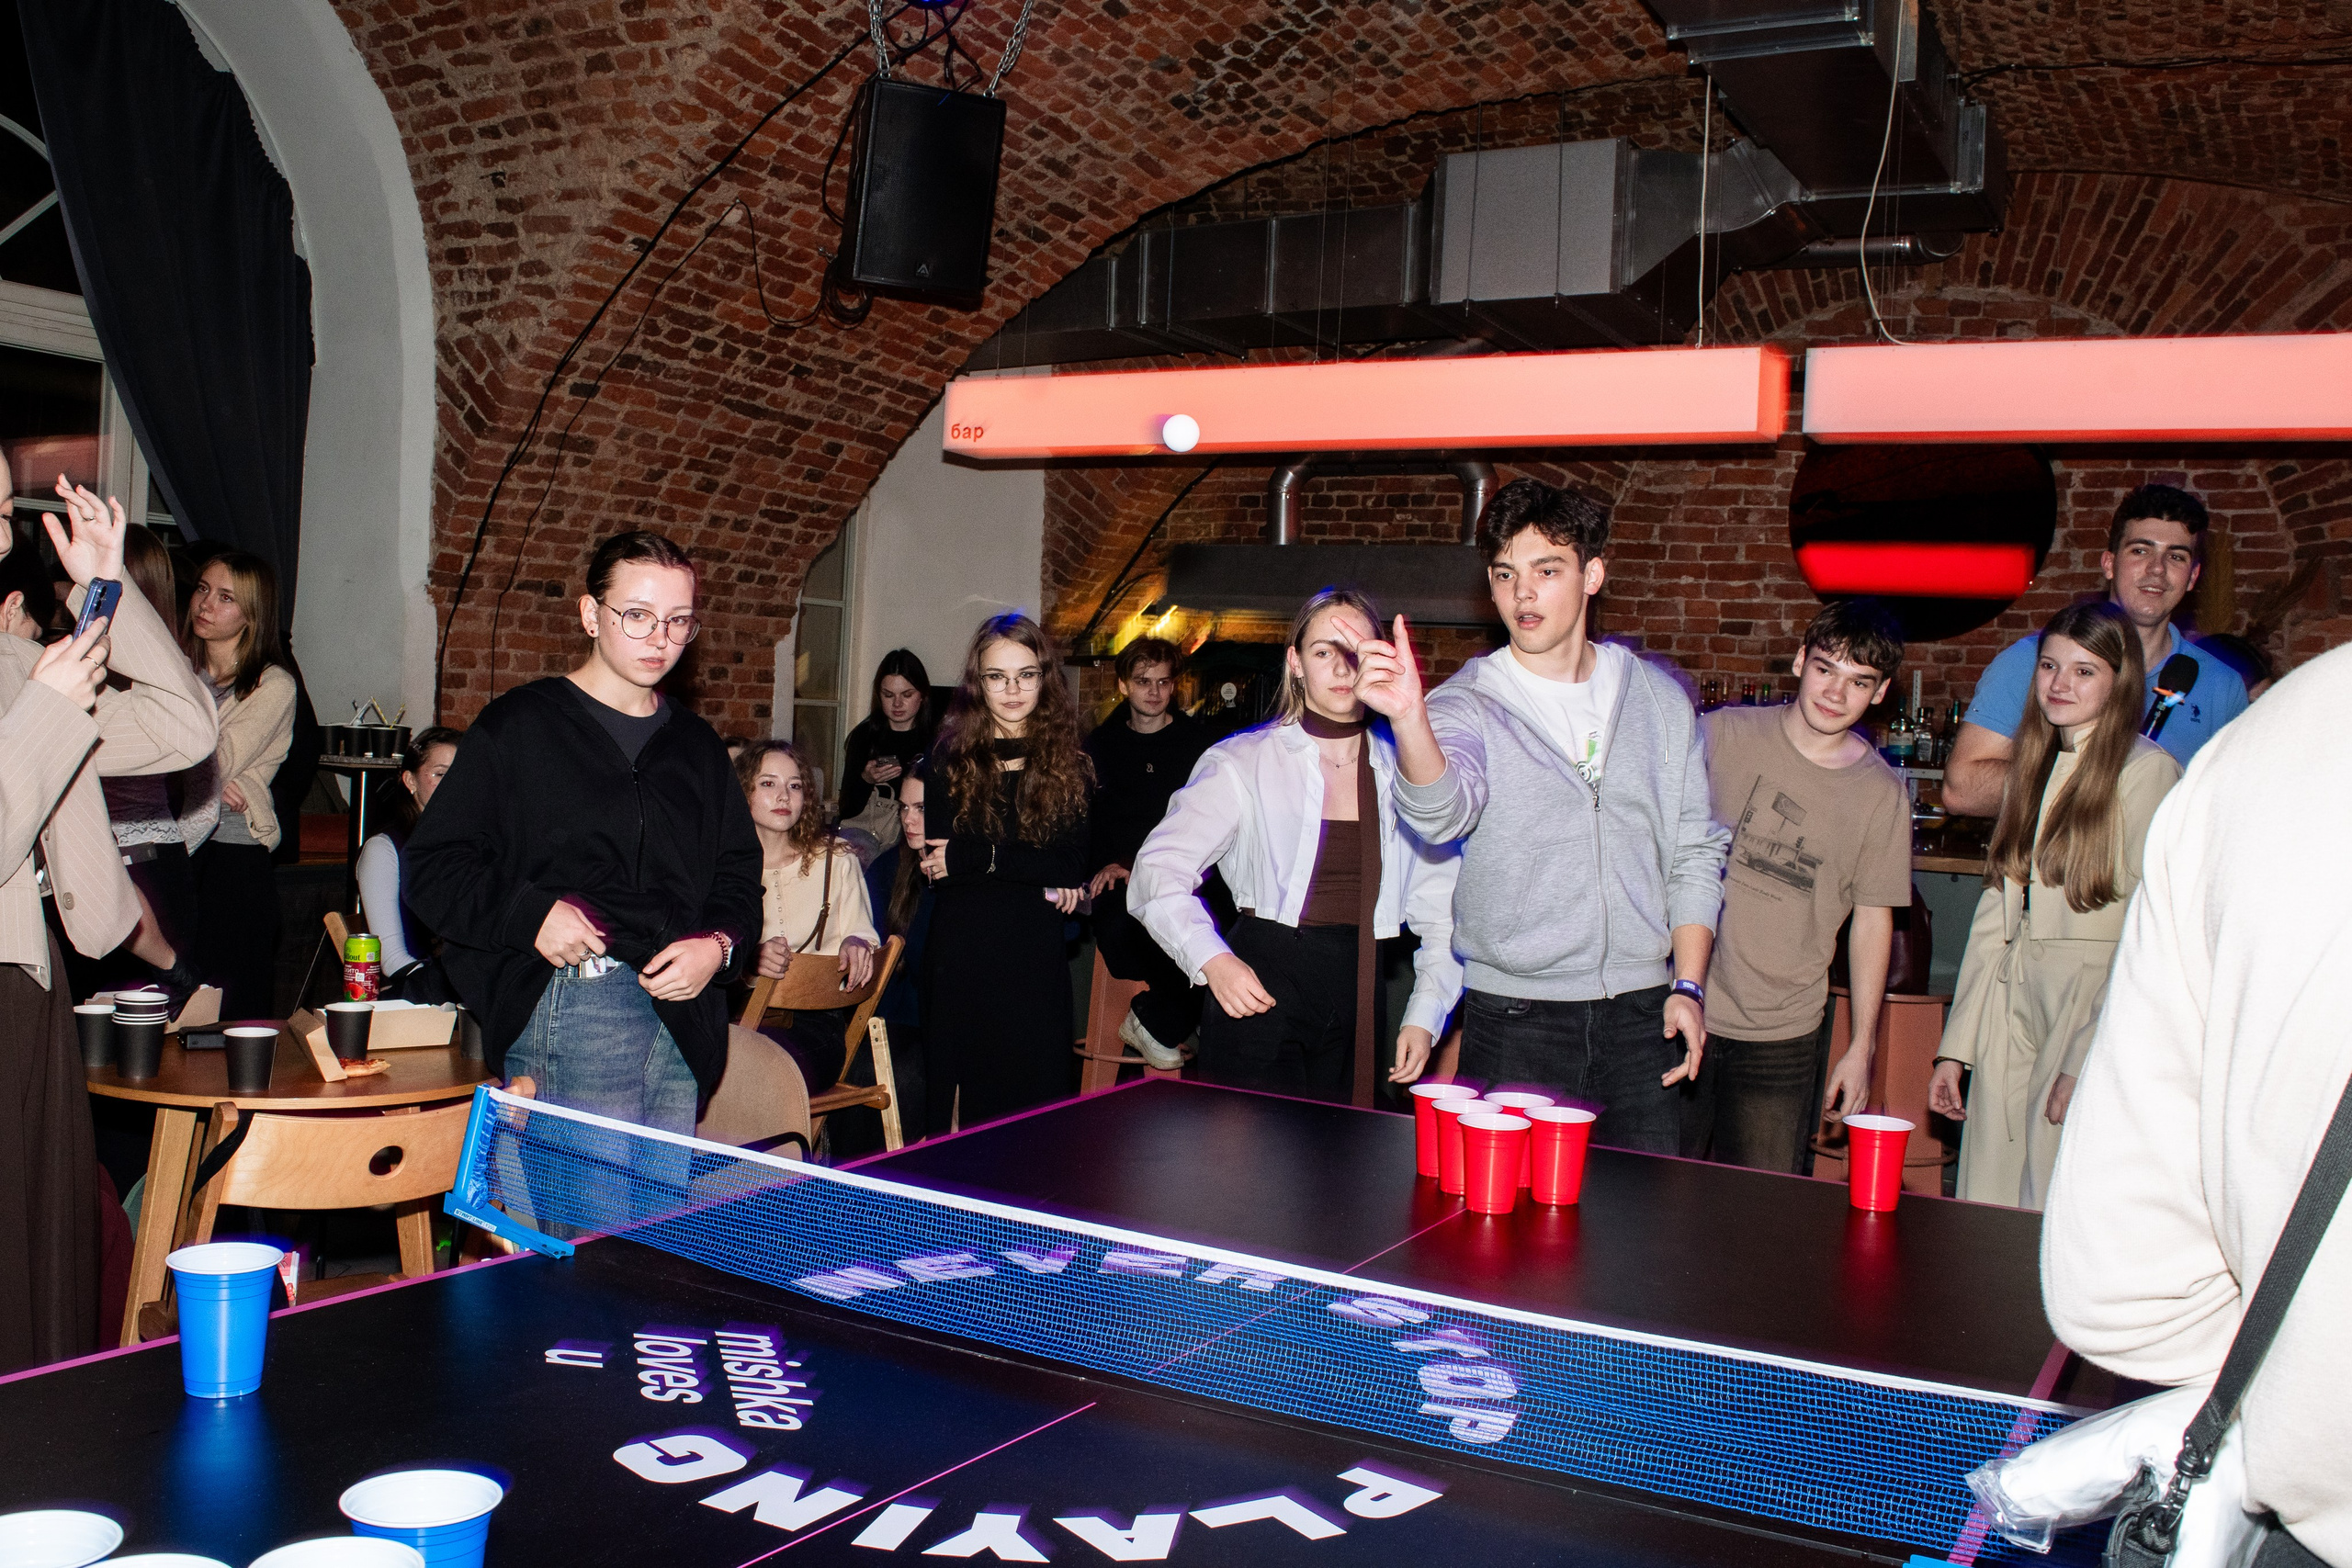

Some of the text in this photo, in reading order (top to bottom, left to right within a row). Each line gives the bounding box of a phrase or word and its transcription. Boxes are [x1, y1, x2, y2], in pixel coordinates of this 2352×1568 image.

[951, 423, 984, 443] бар
[455, 1209, 473, 1221] START
[472, 1216, 484, 1226] LINE
[545, 1348, 604, 1369] u
[633, 1333, 707, 1404] loves
[715, 1331, 814, 1431] mishka
[613, 1252, 1519, 1563] NEVER STOP PLAYING
